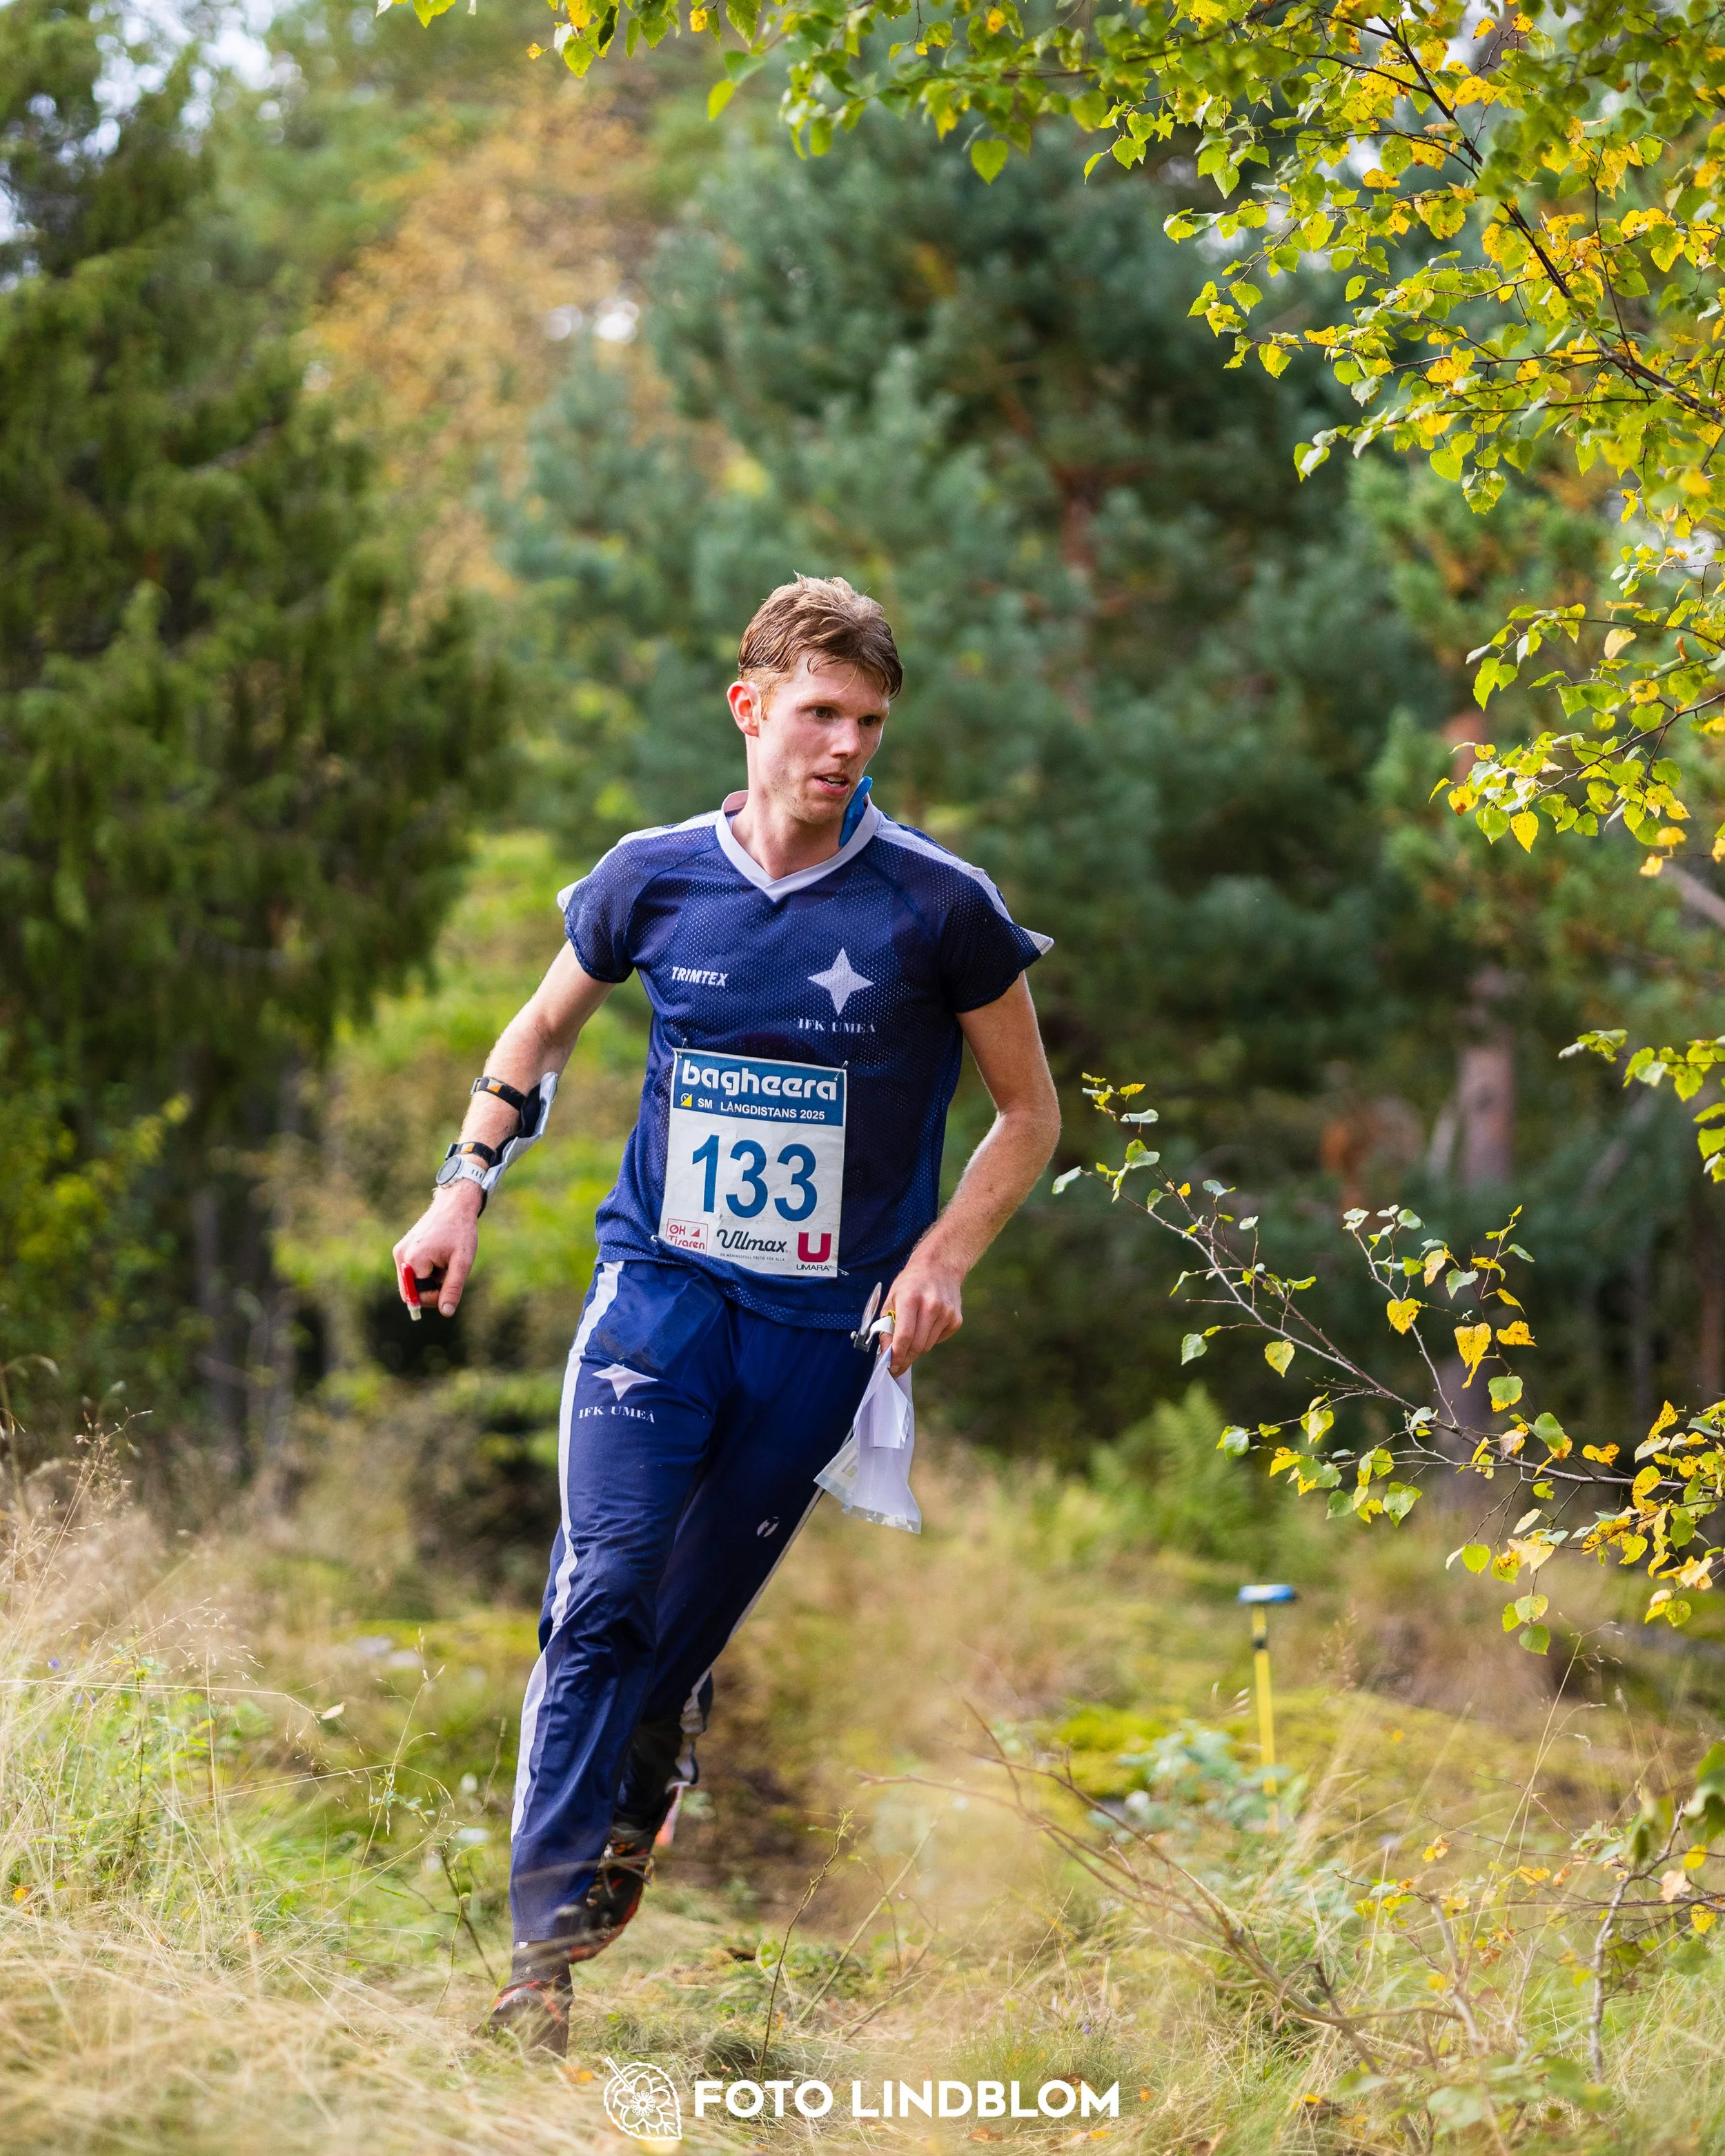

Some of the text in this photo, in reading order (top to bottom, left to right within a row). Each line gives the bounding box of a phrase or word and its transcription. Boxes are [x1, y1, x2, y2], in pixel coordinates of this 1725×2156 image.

[670, 966, 728, 987] TRIMTEX
[797, 1018, 825, 1031] IFK
[682, 1059, 837, 1100] bagheera
[698, 1098, 825, 1120] SM LÅNGDISTANS 2025
[692, 1134, 818, 1222] 133
[669, 1235, 705, 1249] Tisaren
[716, 1229, 787, 1253] Ullmax
[798, 1232, 831, 1263] U
[578, 1405, 655, 1423] IFK UMEÅ
